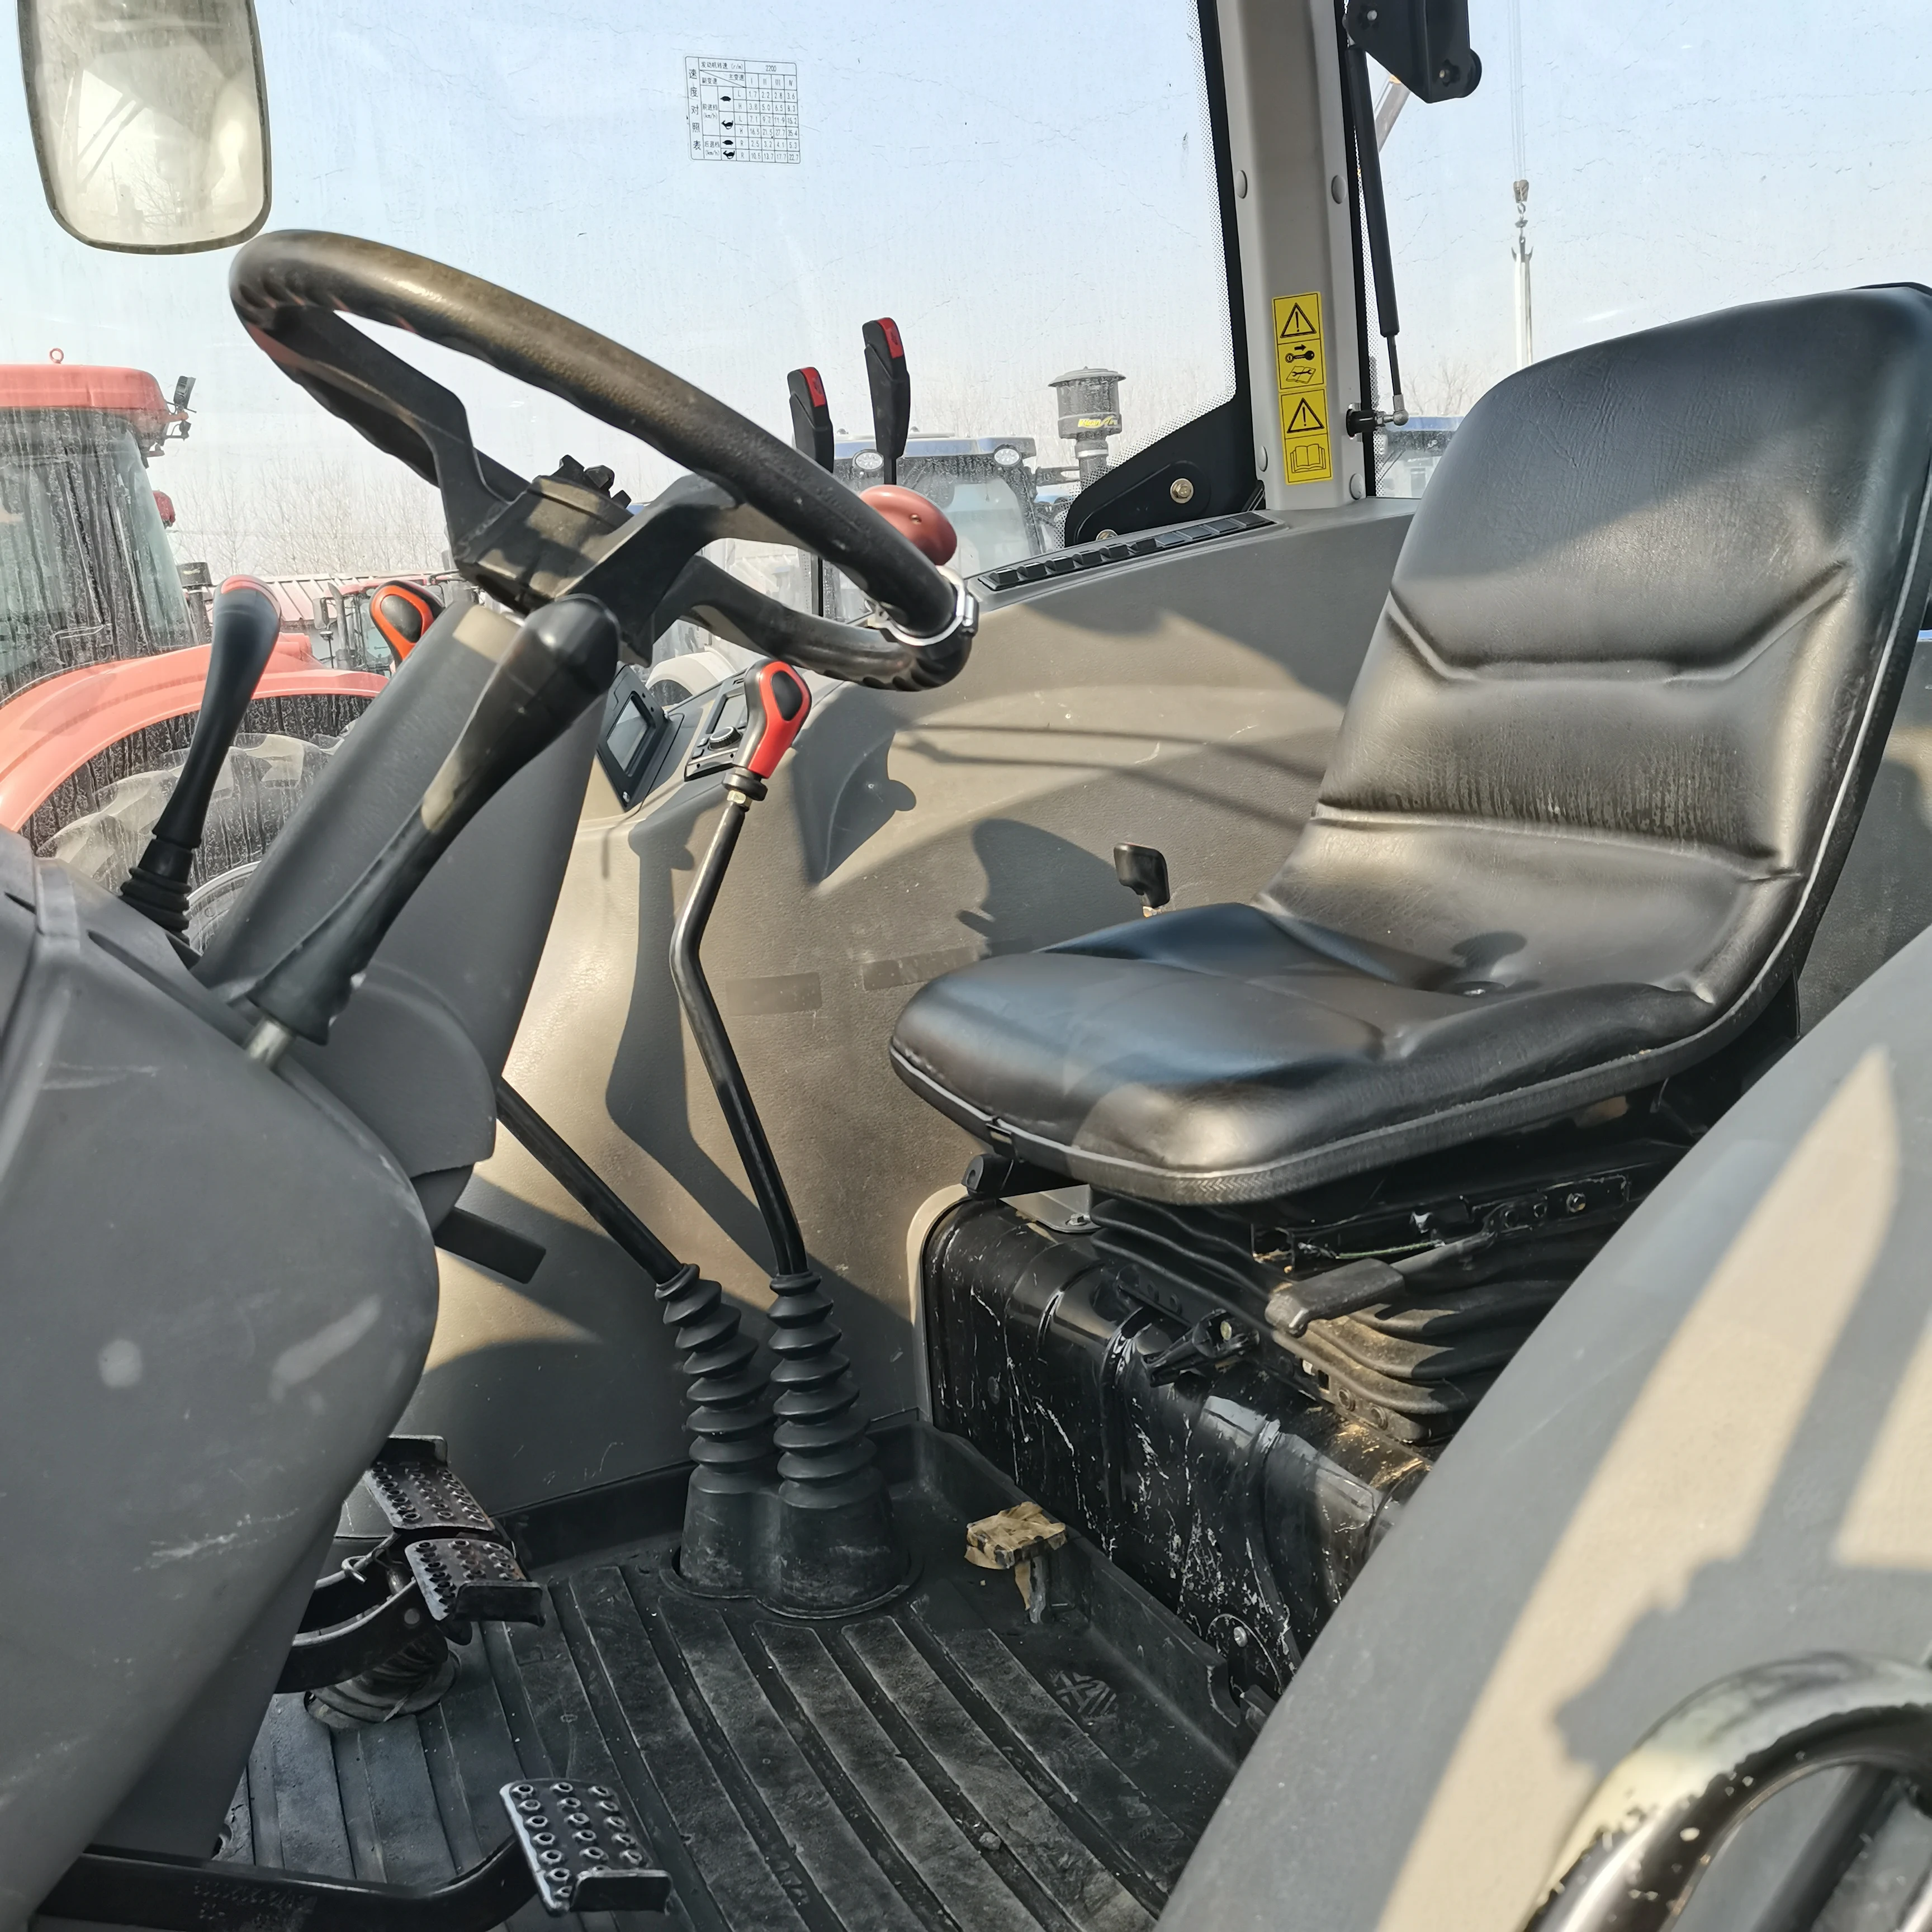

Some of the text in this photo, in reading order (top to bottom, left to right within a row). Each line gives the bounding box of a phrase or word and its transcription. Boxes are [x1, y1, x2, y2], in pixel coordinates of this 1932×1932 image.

[689, 69, 702, 150] 速度对照表
